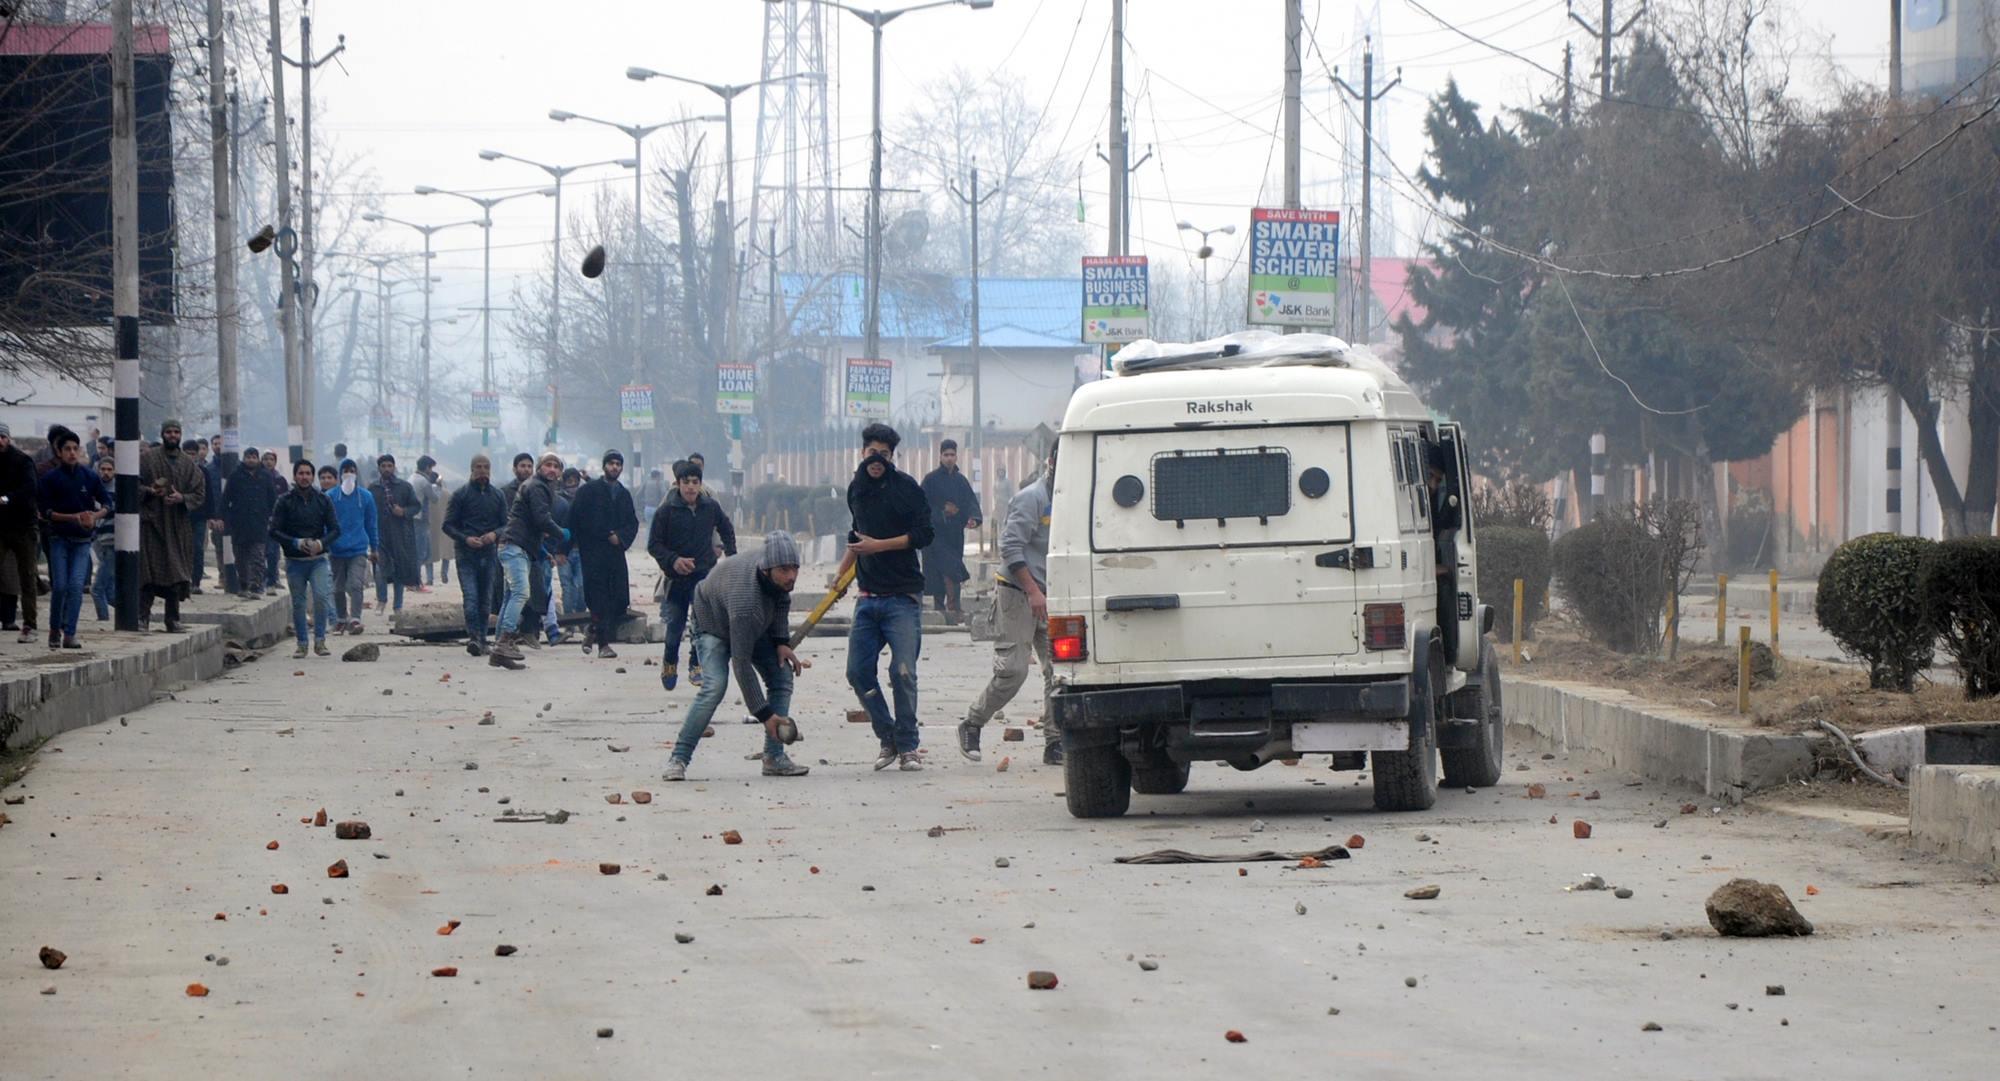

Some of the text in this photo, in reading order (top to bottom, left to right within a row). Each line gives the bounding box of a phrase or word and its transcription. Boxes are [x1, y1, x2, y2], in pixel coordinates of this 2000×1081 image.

[1266, 209, 1328, 221] SAVE WITH
[1255, 221, 1337, 241] SMART
[1255, 239, 1335, 259] SAVER
[1085, 266, 1145, 280] SMALL
[1254, 258, 1336, 277] SCHEME
[1085, 280, 1146, 293] BUSINESS
[1086, 293, 1146, 306] LOAN
[1278, 304, 1331, 317] J&K Bank
[719, 368, 754, 380] HOME
[849, 365, 890, 376] FAIR PRICE
[849, 374, 891, 384] SHOP
[719, 380, 754, 392] LOAN
[848, 383, 890, 394] FINANCE
[621, 390, 652, 398] DAILY
[1186, 399, 1253, 414] Rakshak
